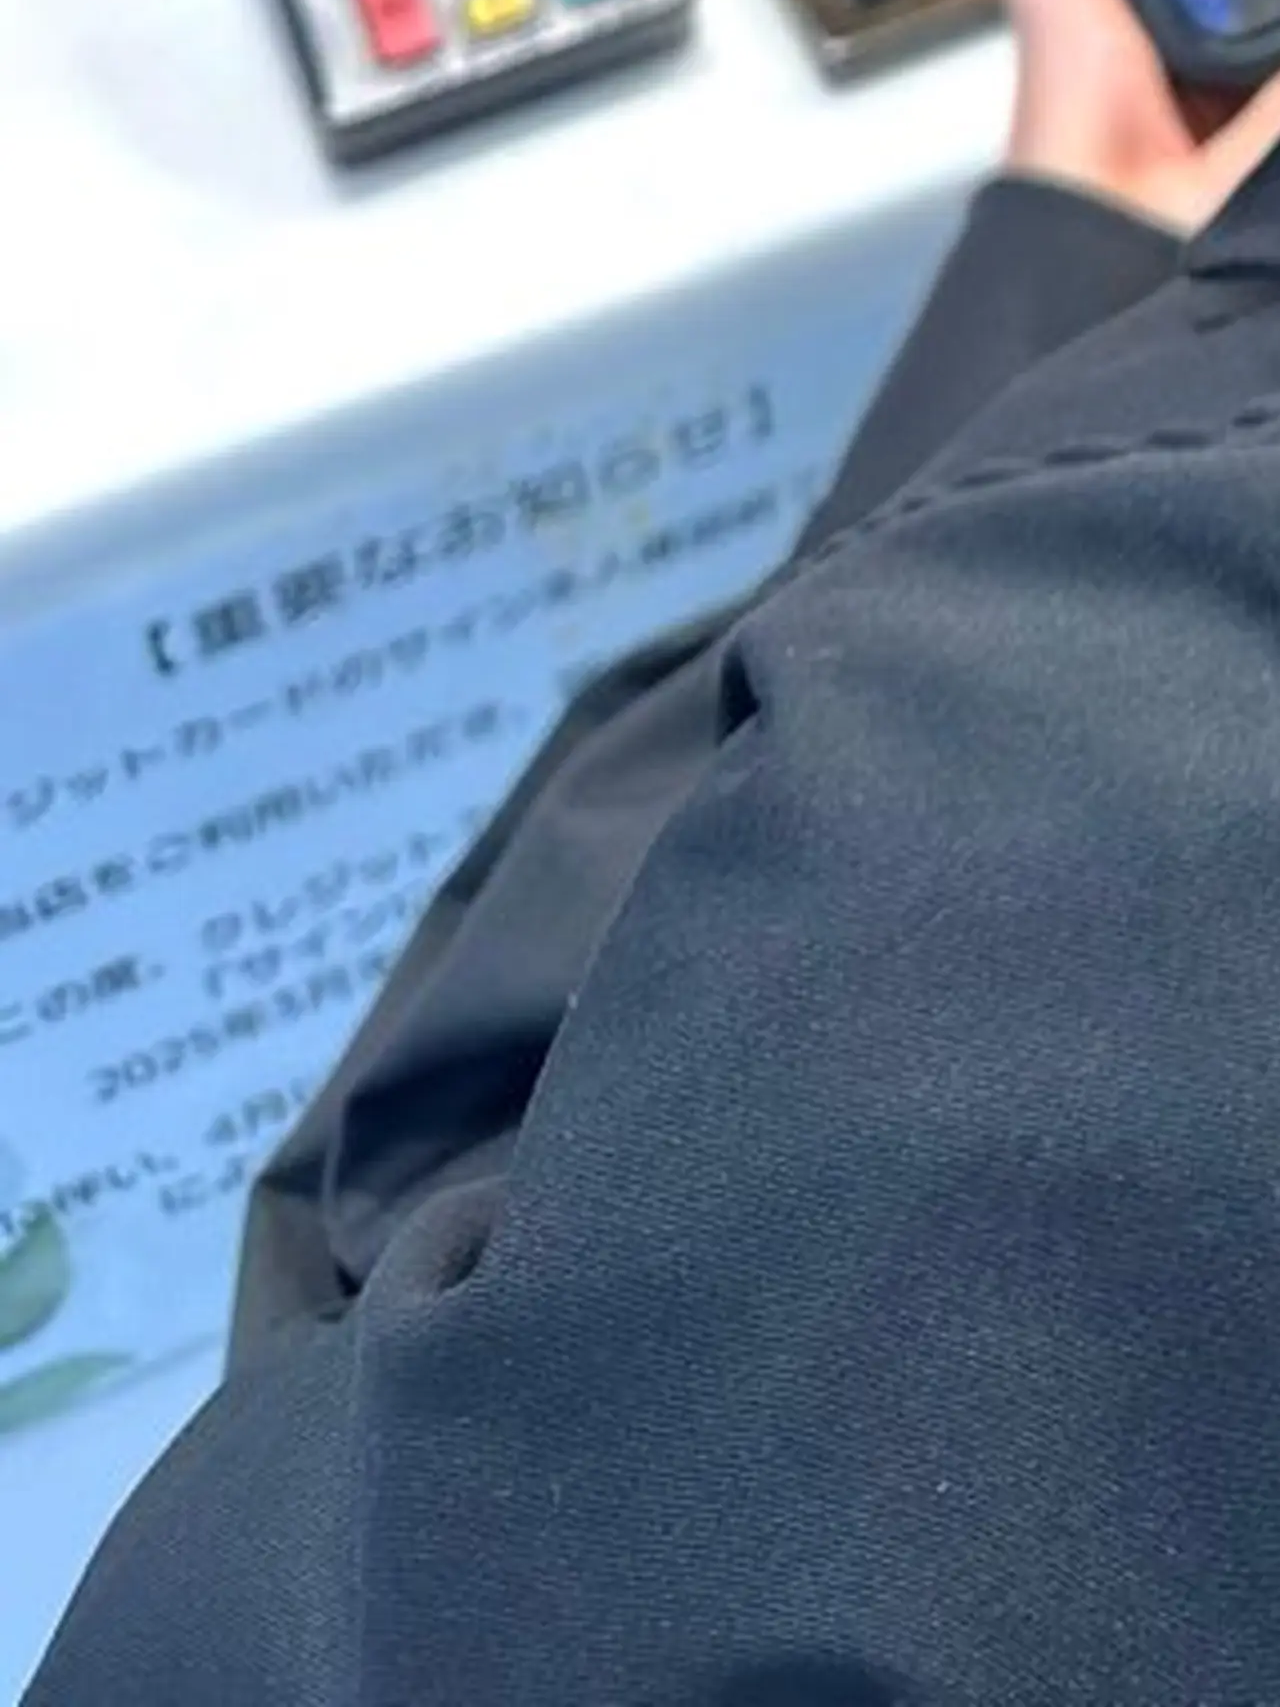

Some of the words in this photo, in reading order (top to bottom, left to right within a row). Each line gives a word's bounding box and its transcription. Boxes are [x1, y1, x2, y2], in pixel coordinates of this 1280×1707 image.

[146, 384, 773, 677] 【重要なお知らせ】
